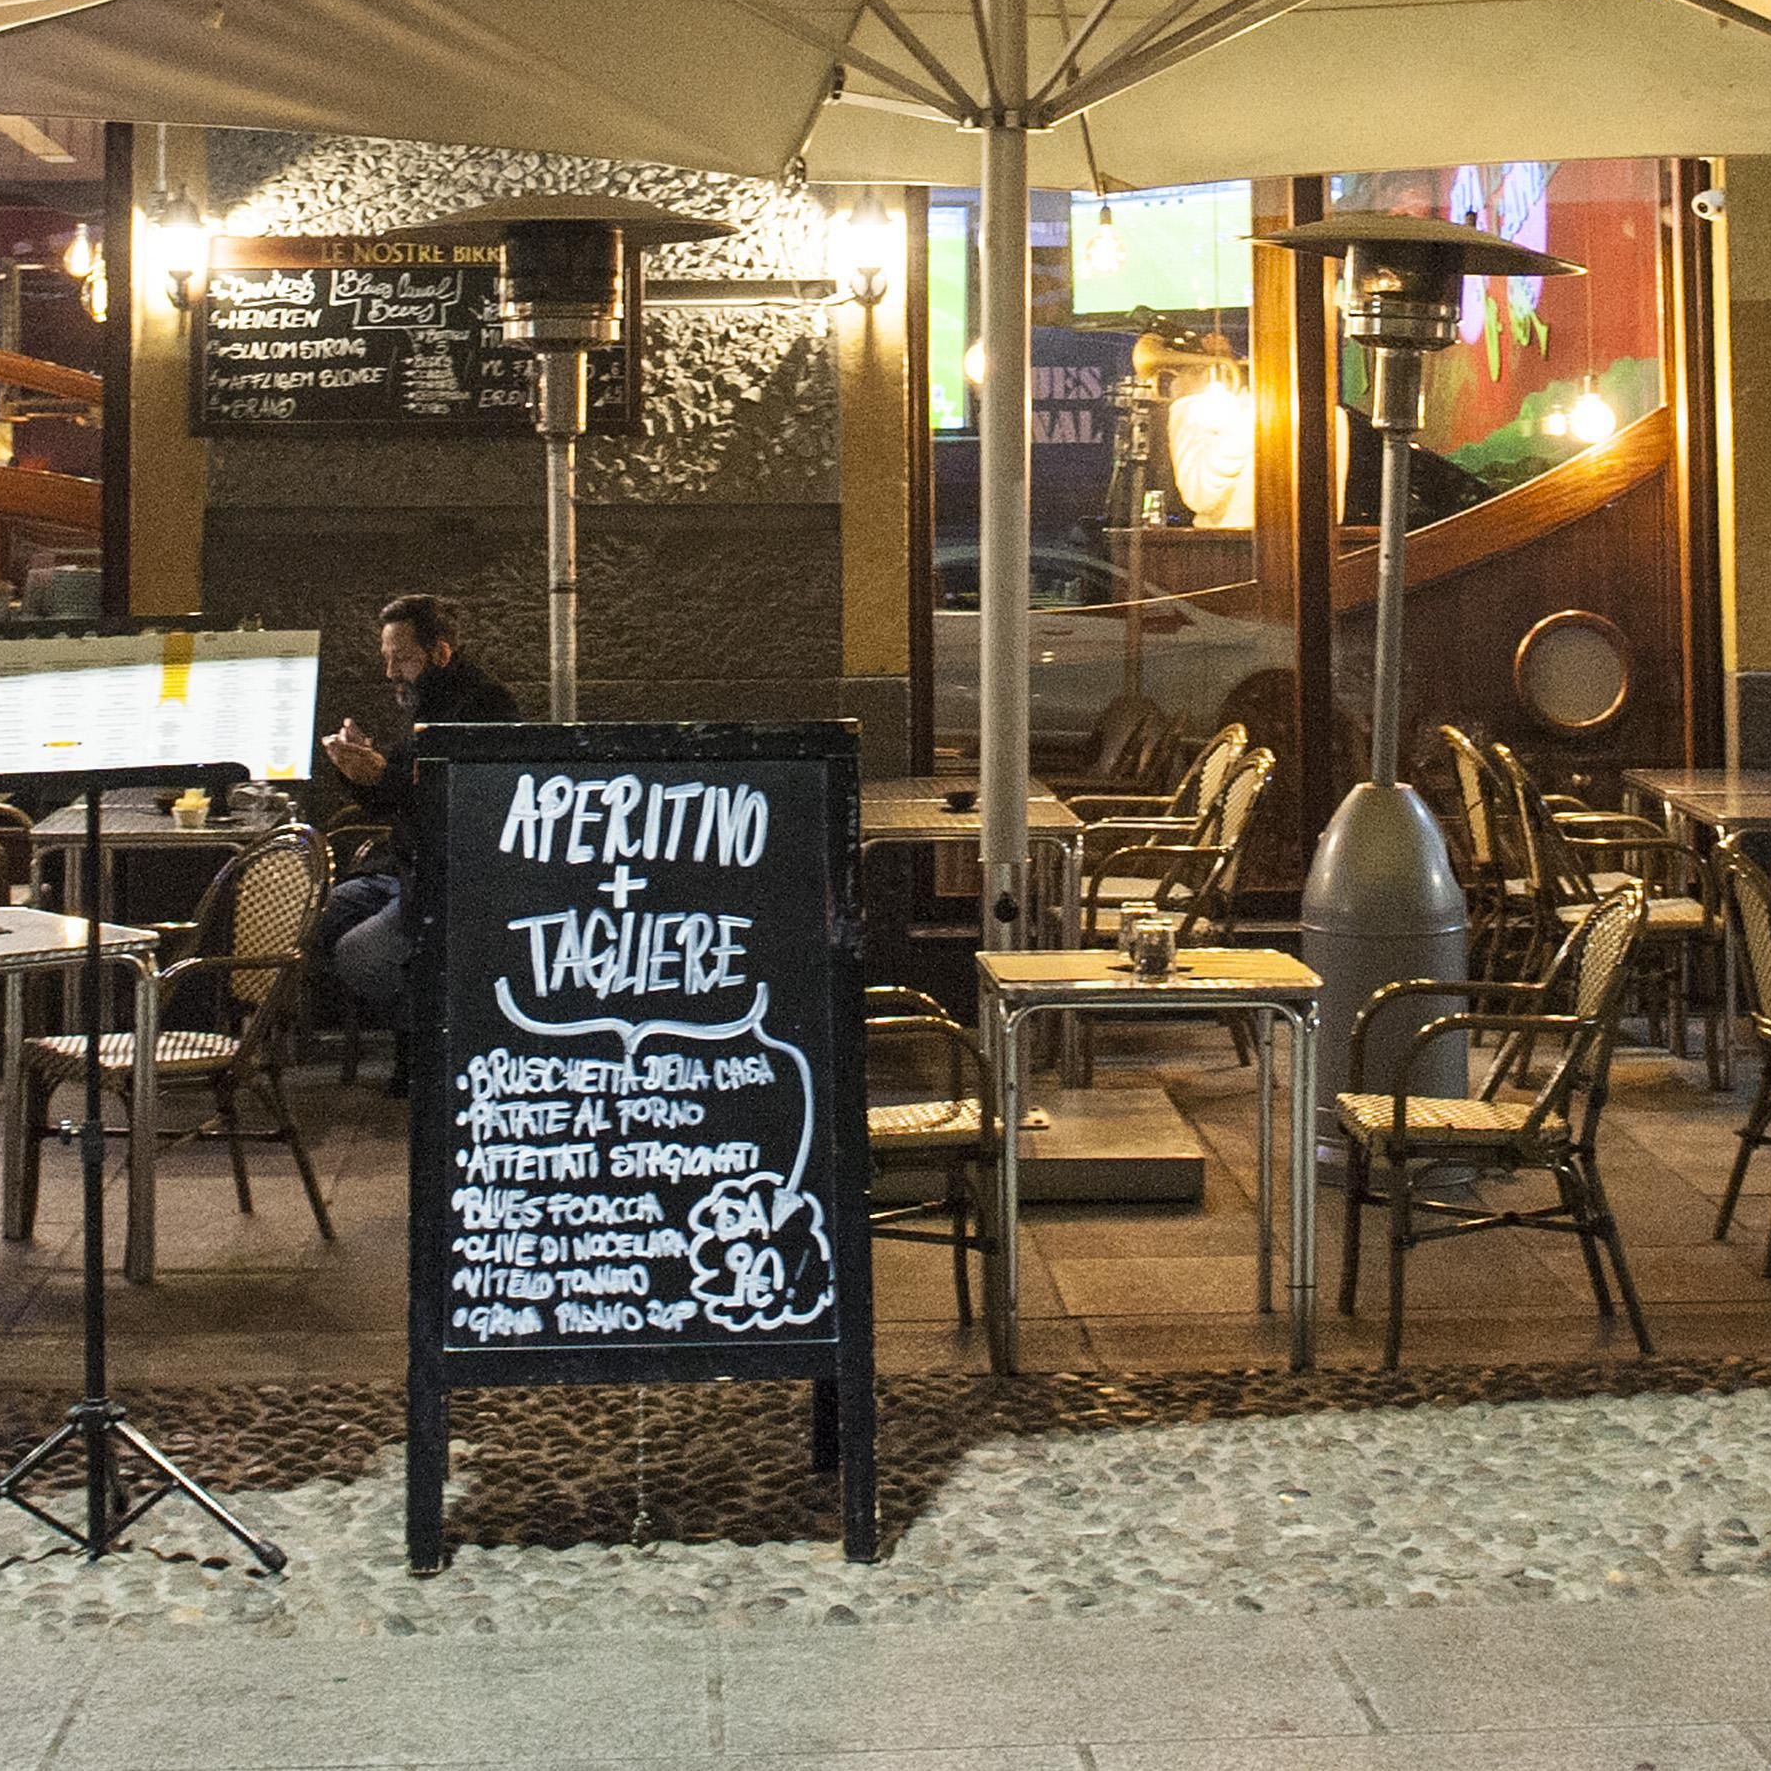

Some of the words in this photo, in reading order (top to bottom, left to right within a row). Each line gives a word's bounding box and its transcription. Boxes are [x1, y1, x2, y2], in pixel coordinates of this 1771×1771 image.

[353, 241, 445, 264] NOSTRE
[499, 774, 770, 868] APERITIVO
[508, 906, 753, 999] TAGLIERE
[468, 1048, 640, 1100] BRUSCHETTA
[714, 1052, 776, 1091] CASA
[469, 1099, 572, 1144] PATATE
[573, 1096, 612, 1137] AL
[616, 1095, 706, 1136] FORNO
[464, 1231, 540, 1267] OLIVE
[540, 1235, 568, 1265] DI
